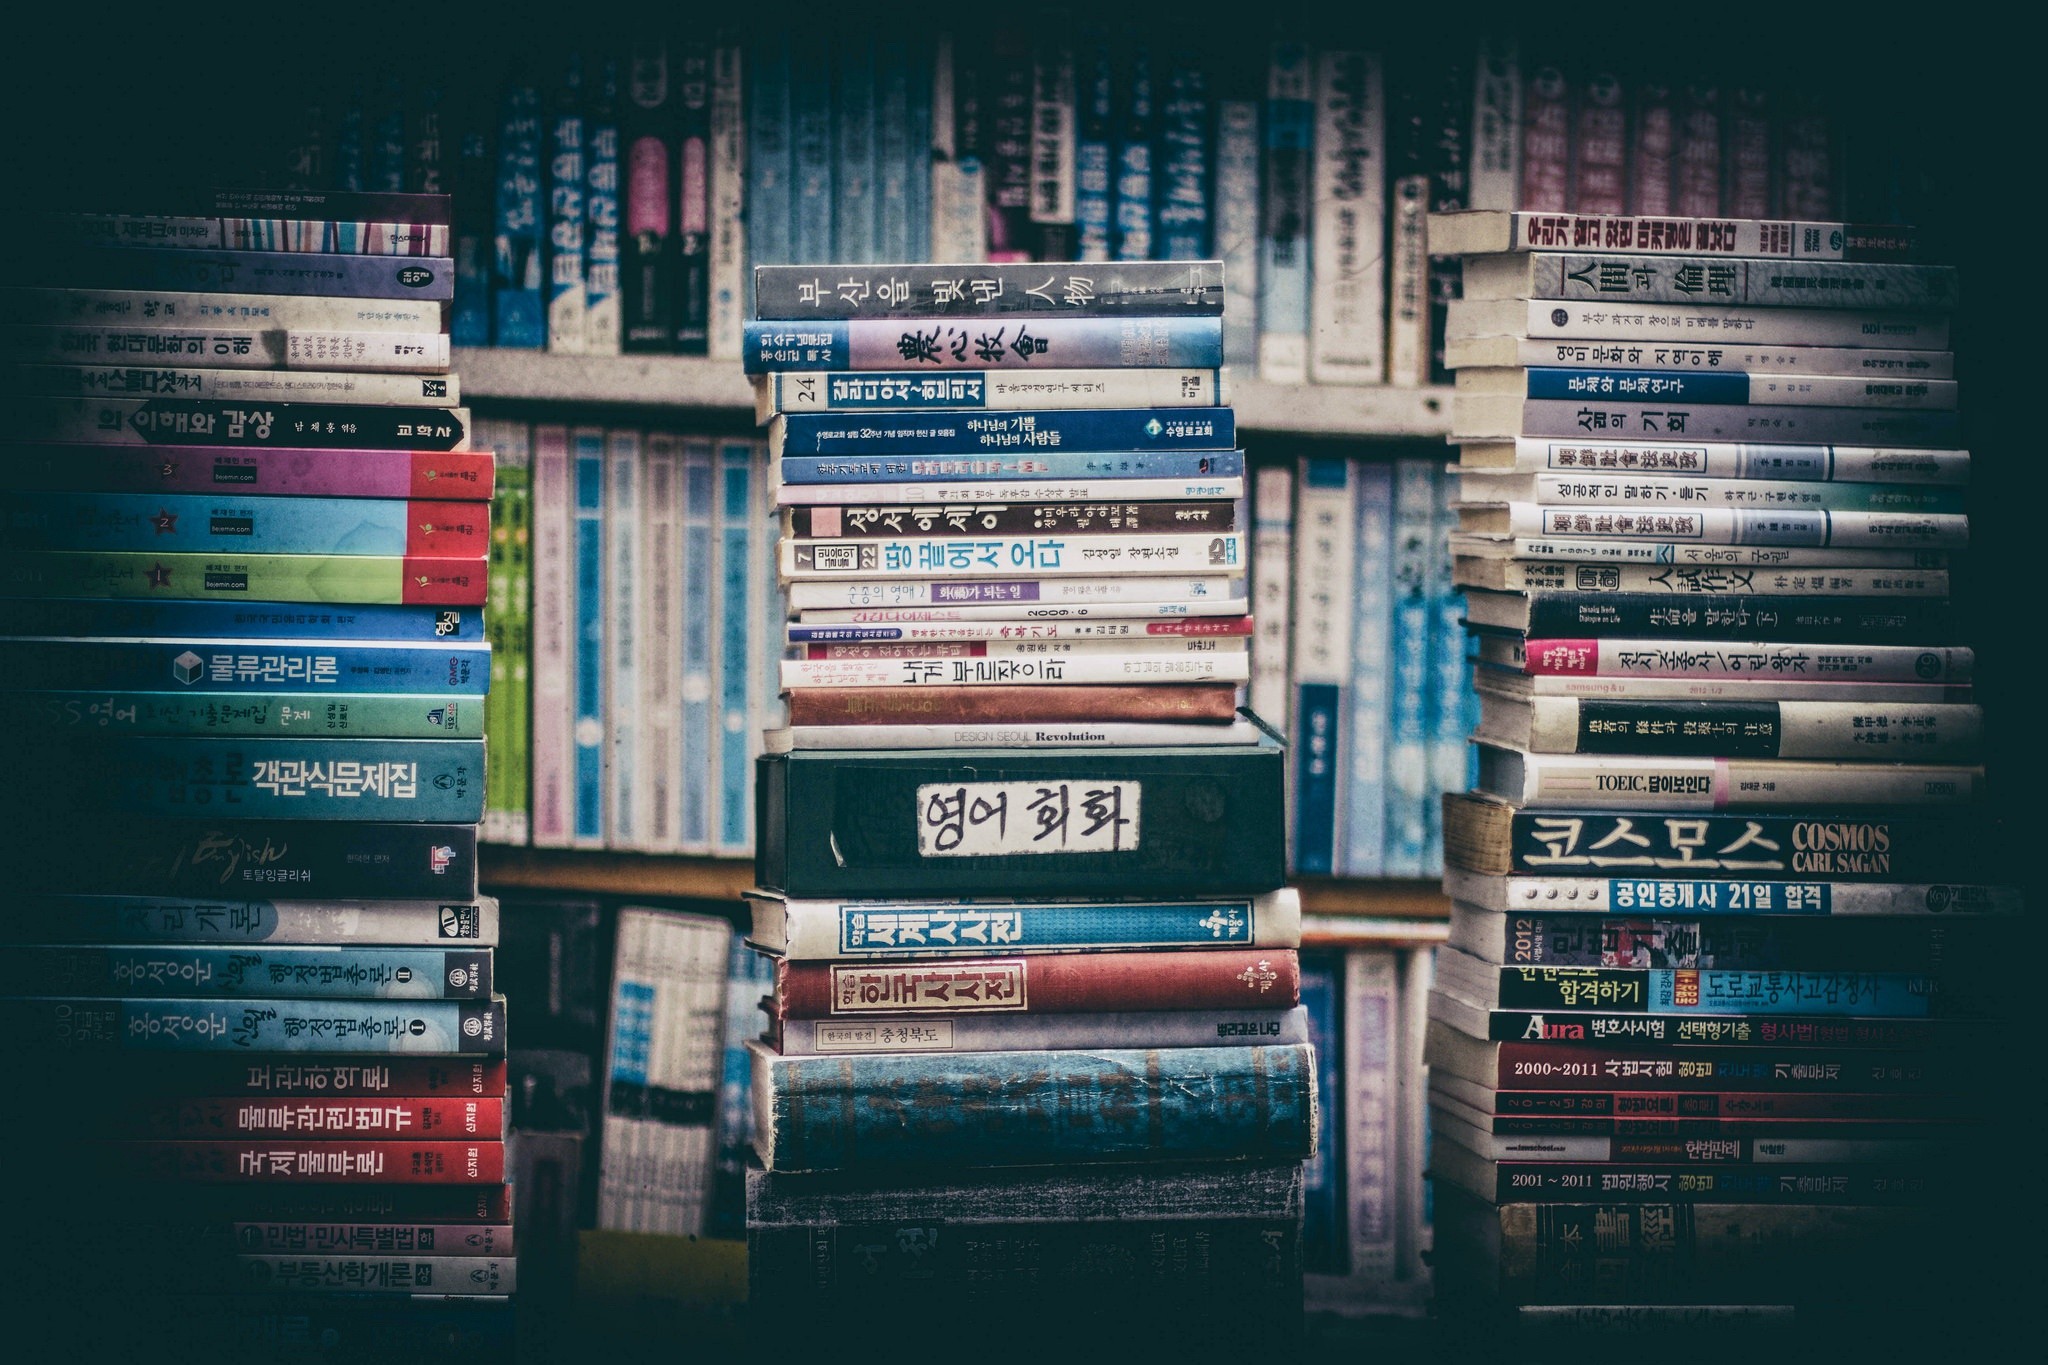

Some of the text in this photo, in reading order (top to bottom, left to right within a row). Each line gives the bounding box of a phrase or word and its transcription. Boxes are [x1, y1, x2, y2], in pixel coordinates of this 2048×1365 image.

[1529, 217, 1736, 252] 우리가 알고 있던 마케팅은 끝났다
[1812, 229, 1820, 252] ZYMAN
[404, 270, 430, 285] 태일
[1568, 262, 1735, 297] 人間과 倫理
[799, 275, 1096, 307] 부산을 빛낸 人物
[1612, 313, 1755, 332] 과거의 창으로 미래를 말하다
[107, 333, 252, 355] 현대문학의 이해
[807, 350, 832, 363] 목사
[1557, 346, 1721, 367] 영미 문화와 지역이해
[797, 377, 983, 403] 24 갈라디아서~히브리서
[1568, 376, 1684, 395] 문체와 문체연구
[134, 412, 215, 434] 이해와
[222, 410, 273, 439] 감상
[397, 424, 451, 437] 교학사
[967, 416, 1035, 435] 하나님의 기쁨
[1167, 427, 1214, 438] 수영로교회
[1577, 407, 1689, 433] 삶의 기회
[859, 428, 936, 441] 32주년 기념 글
[980, 431, 1061, 449] 하나님의 사람들
[162, 463, 173, 475] 3
[886, 463, 907, 474] 대한
[1034, 488, 1087, 499] 수상자 발표
[1558, 484, 1618, 500] 성공적인
[160, 518, 170, 527] 2
[847, 505, 1007, 533] 성서에세이
[1043, 506, 1120, 517] 미우라 아야꼬
[797, 554, 810, 568] 7
[817, 549, 851, 559] 믿음의
[861, 540, 1178, 570] 22 땅 끝에서 오다 김성일 장편소설
[1561, 548, 1789, 564] 1997년 서울의 궁궐
[155, 569, 160, 583] 1
[847, 585, 1107, 604] 순종의 열매 되는 일 사람
[1610, 615, 1621, 624] Life
[1650, 606, 1750, 627] 生命을 말한다
[1000, 625, 1128, 640] 축복기도 김태원
[832, 641, 1214, 657] 영성이 깊어지는 큐티 송원준 지음 두란노
[209, 655, 338, 683] 물류관리론
[460, 660, 470, 684] 박문각
[902, 660, 942, 685] 내게
[1919, 655, 1936, 676] 29
[811, 673, 859, 684] 하나님의
[1566, 684, 1609, 695] samsung
[89, 698, 310, 726] 영어 기출문제집 문제
[327, 704, 335, 728] 신성일
[954, 732, 1105, 743] DESIGN SEOUL Revolution
[251, 760, 417, 799] 객관식문제집
[453, 767, 463, 799] 박문각
[1596, 773, 1776, 795] TOEIC, 답이보인다 김대균 지음
[927, 785, 1129, 850] 영어 회화
[1522, 817, 1785, 872] 코스모스
[1791, 821, 1890, 853] COSMOS
[1791, 852, 1890, 875] CARL SAGAN
[242, 869, 311, 884] 토탈잉글리쉬
[1616, 882, 1718, 910] 공인중개사
[1728, 883, 1772, 911] 21일
[1785, 884, 1821, 911] 합격
[853, 914, 864, 945] 학습
[867, 911, 1020, 946] 세계사사전
[1229, 909, 1243, 938] 계몽사
[1515, 920, 1532, 961] 2012
[1534, 934, 1542, 961] 사법시험
[268, 961, 390, 986] 행정법총론
[1259, 960, 1277, 993] 계몽사
[842, 975, 855, 1004] 학습
[860, 971, 1017, 1004] 한국사사전
[1558, 980, 1642, 1006] 합격하기
[1707, 974, 1880, 1006] 도로교통사고감정사
[283, 1013, 406, 1039] 행정법총론
[828, 1022, 1279, 1044] 한국의 발견 충청북도 뿌리깊은 나무
[1521, 1015, 1752, 1043] Aura 변호사시험 선택형기출
[246, 1065, 388, 1091] 보관하역론
[473, 1063, 482, 1094] 신지원
[1515, 1059, 1841, 1084] 2000~2011 사법시험 형법 기출문제
[239, 1105, 412, 1132] 물류관련법규
[466, 1103, 475, 1133] 신지원
[1685, 1139, 1740, 1161] 헌법판례
[240, 1150, 384, 1176] 국제물류론
[468, 1148, 477, 1178] 신지원
[1512, 1172, 1849, 1196] 2001 2011 법원행시 형법 기출문제
[267, 1225, 432, 1251] 민법·민사특별법 하
[487, 1228, 495, 1253] 박문각
[276, 1262, 429, 1286] 부동산학개론 상
[489, 1263, 498, 1290] 박문각
